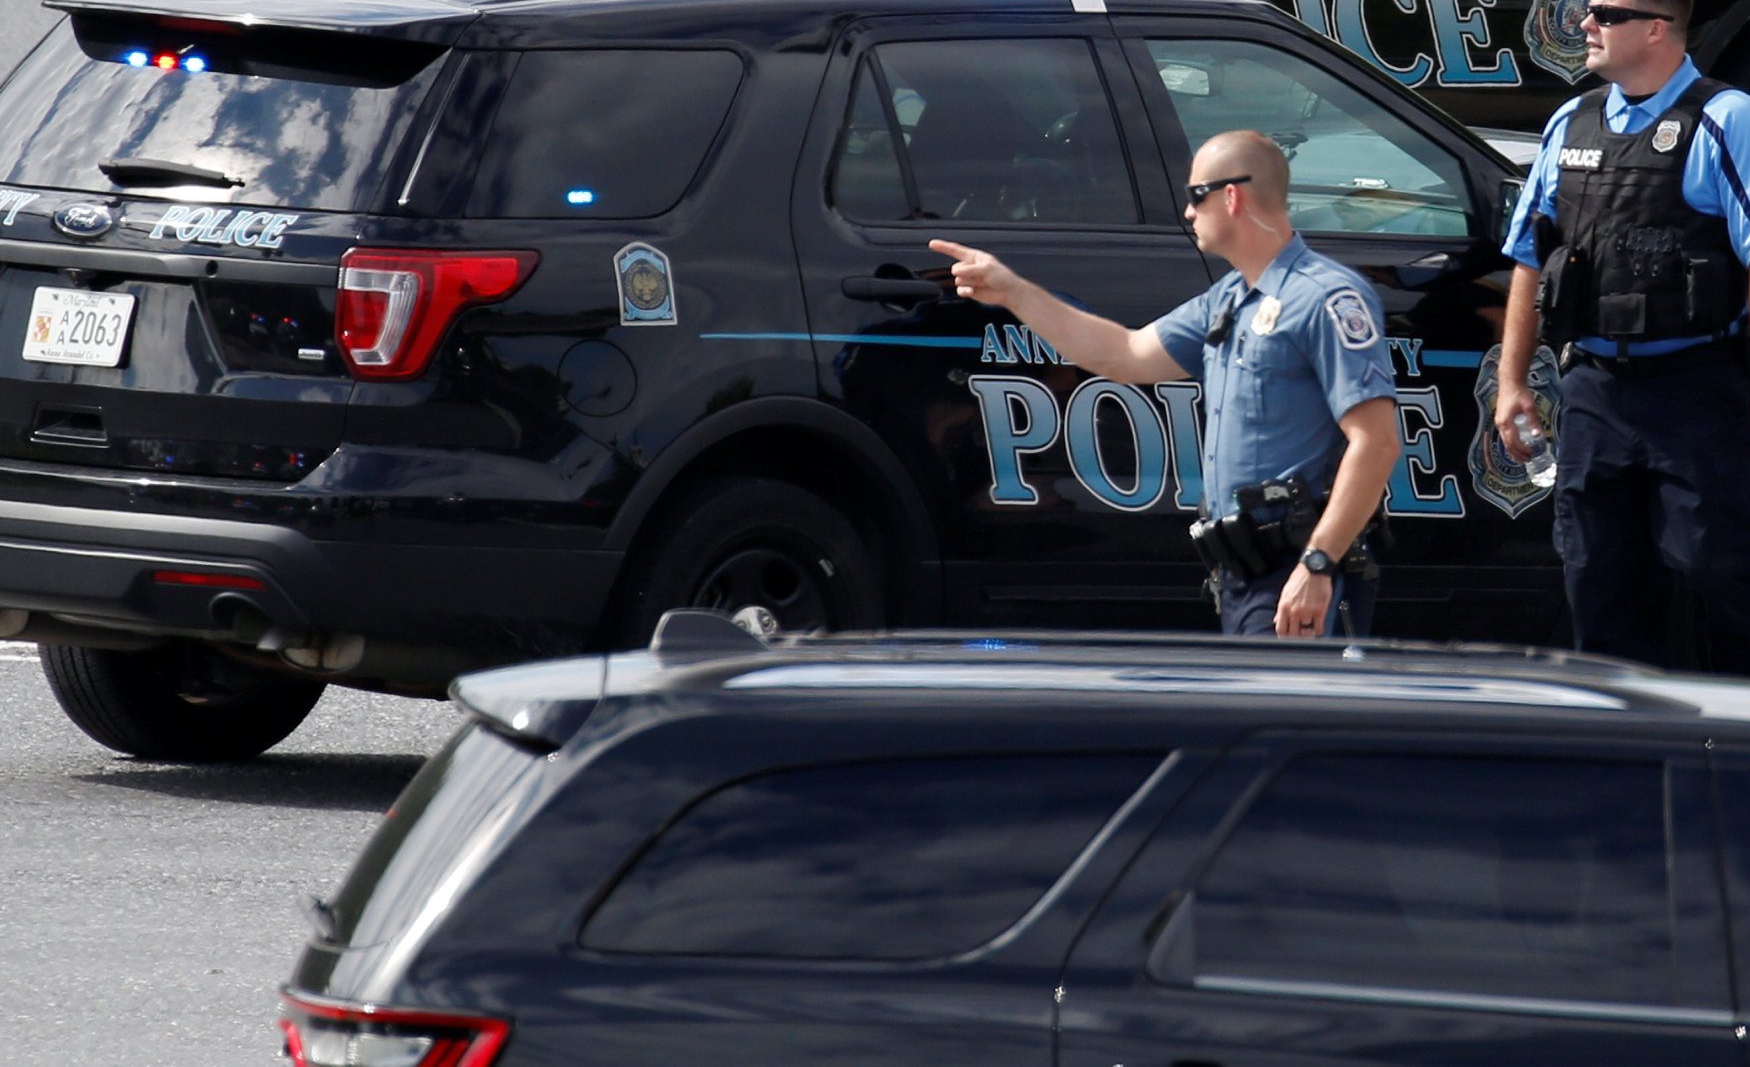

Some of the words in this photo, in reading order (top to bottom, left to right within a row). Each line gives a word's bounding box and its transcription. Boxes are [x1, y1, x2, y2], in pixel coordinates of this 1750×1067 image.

[1559, 148, 1603, 167] POLICE
[64, 207, 97, 230] Ford
[150, 206, 299, 249] POLICE
[69, 309, 122, 346] 2063
[981, 323, 1079, 365] ANN
